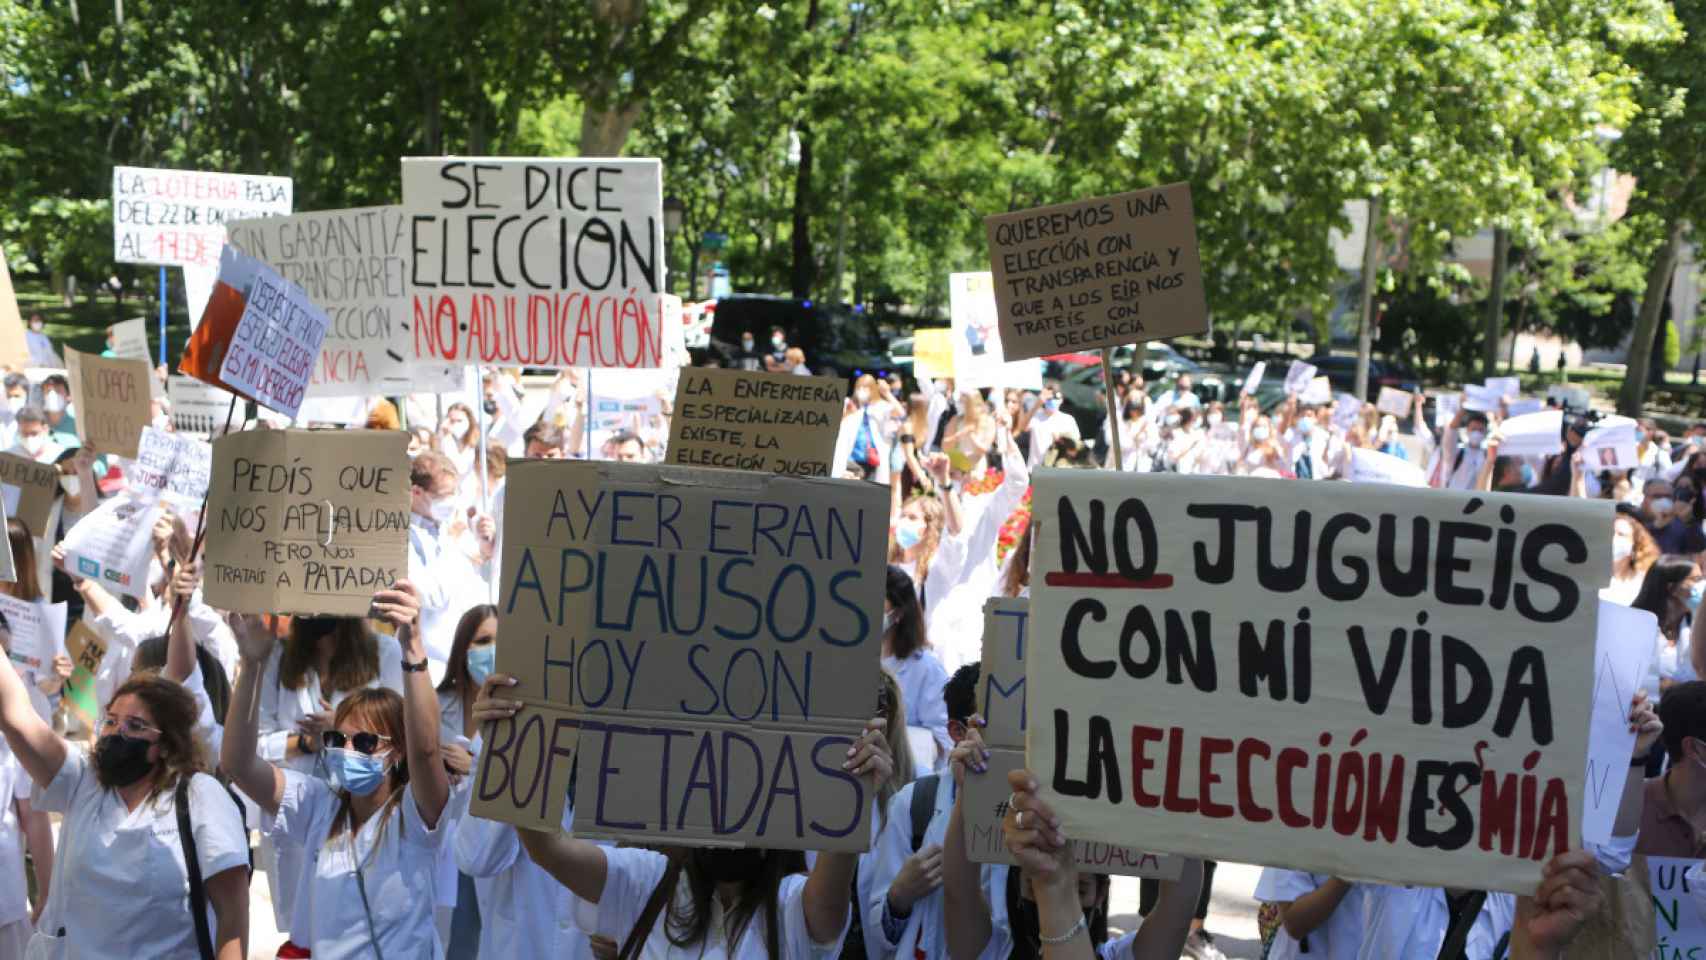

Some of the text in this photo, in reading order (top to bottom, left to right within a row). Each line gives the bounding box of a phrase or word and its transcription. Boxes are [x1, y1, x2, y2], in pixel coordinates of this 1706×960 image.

[118, 172, 146, 195] LA
[441, 163, 623, 213] SE DICE
[118, 200, 153, 226] DEL
[159, 203, 179, 225] 22
[184, 205, 201, 225] DE
[996, 193, 1170, 246] QUEREMOS UNA
[120, 232, 146, 259] AL
[153, 232, 178, 260] 17
[230, 227, 268, 260] SIN
[1097, 234, 1133, 255] CON
[1008, 251, 1160, 297] TRANSPARENCIA
[1168, 247, 1181, 266] Y
[1010, 300, 1043, 317] QUE
[1052, 296, 1064, 312] A
[1070, 289, 1103, 307] LOS
[1147, 273, 1185, 294] NOS
[1107, 301, 1139, 321] CON
[1054, 319, 1145, 348] DECENCIA
[225, 343, 246, 376] ES
[310, 350, 370, 385] NCIA
[685, 376, 842, 403] LA ENFERMERÍA
[682, 403, 830, 427] ESPECIALIZADA
[680, 425, 780, 449] EXISTE, LA
[232, 457, 313, 496] PEDÍS
[339, 465, 393, 495] QUE
[677, 448, 829, 476] ELECCIÓN JUSTA
[221, 503, 410, 535] NOS APLAUDAN
[546, 489, 864, 564] AYER ERAN
[264, 540, 355, 564] PERO NOS
[1057, 496, 1588, 623] NO JUGUÉIS
[276, 570, 291, 589] A
[303, 561, 398, 592] PATADAS
[506, 548, 871, 648] APLAUSOS
[1060, 598, 1217, 692] CON
[543, 635, 813, 722] HOY SON
[478, 714, 866, 839] BOFETADAS
[1053, 708, 1123, 804] LA
[1131, 727, 1405, 844] ELECCIÓN
[1406, 758, 1484, 851] ES
[1478, 750, 1570, 861] MÍA
